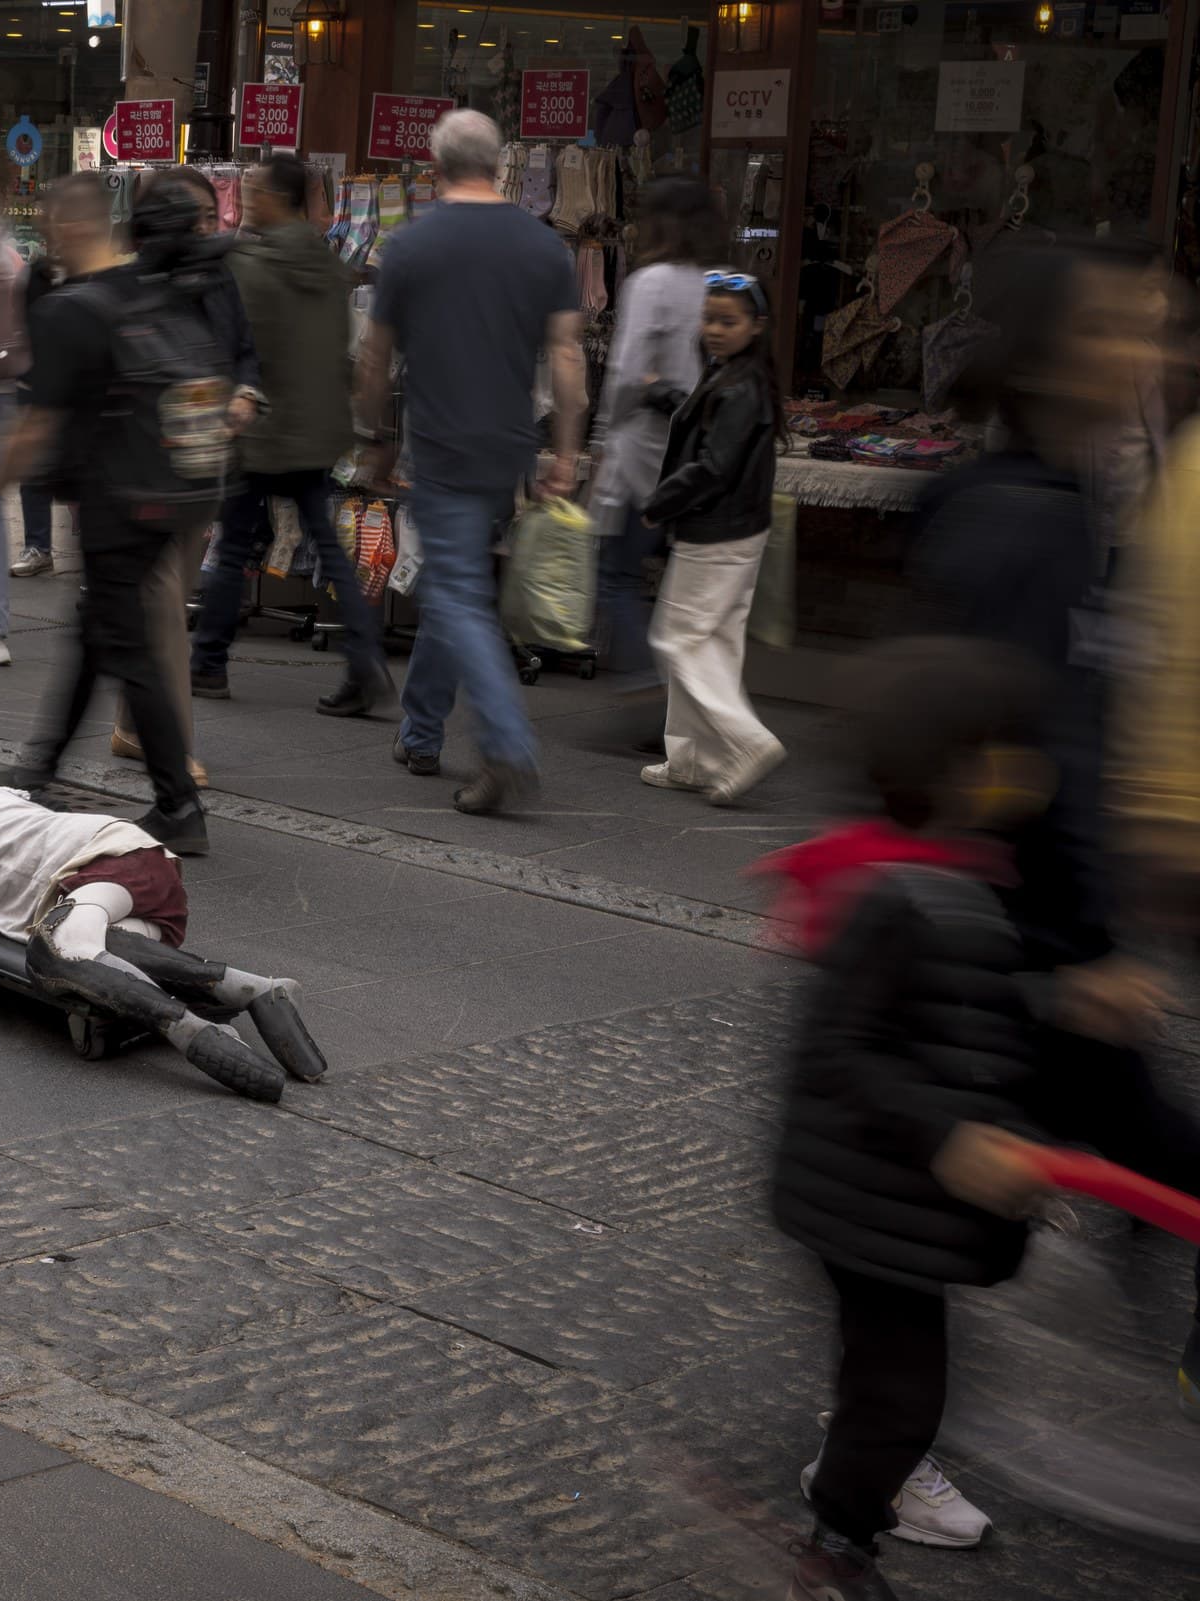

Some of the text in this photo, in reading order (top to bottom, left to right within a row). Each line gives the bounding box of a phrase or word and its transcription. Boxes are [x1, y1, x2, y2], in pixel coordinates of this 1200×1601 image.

[271, 41, 293, 51] Gallery
[541, 96, 574, 111] 3,000
[726, 90, 772, 107] CCTV
[258, 108, 288, 122] 3,000
[540, 110, 573, 125] 5,000
[135, 124, 164, 138] 3,000
[257, 121, 287, 135] 5,000
[395, 120, 435, 136] 3,000
[135, 136, 164, 150] 5,000
[394, 134, 433, 150] 5,000
